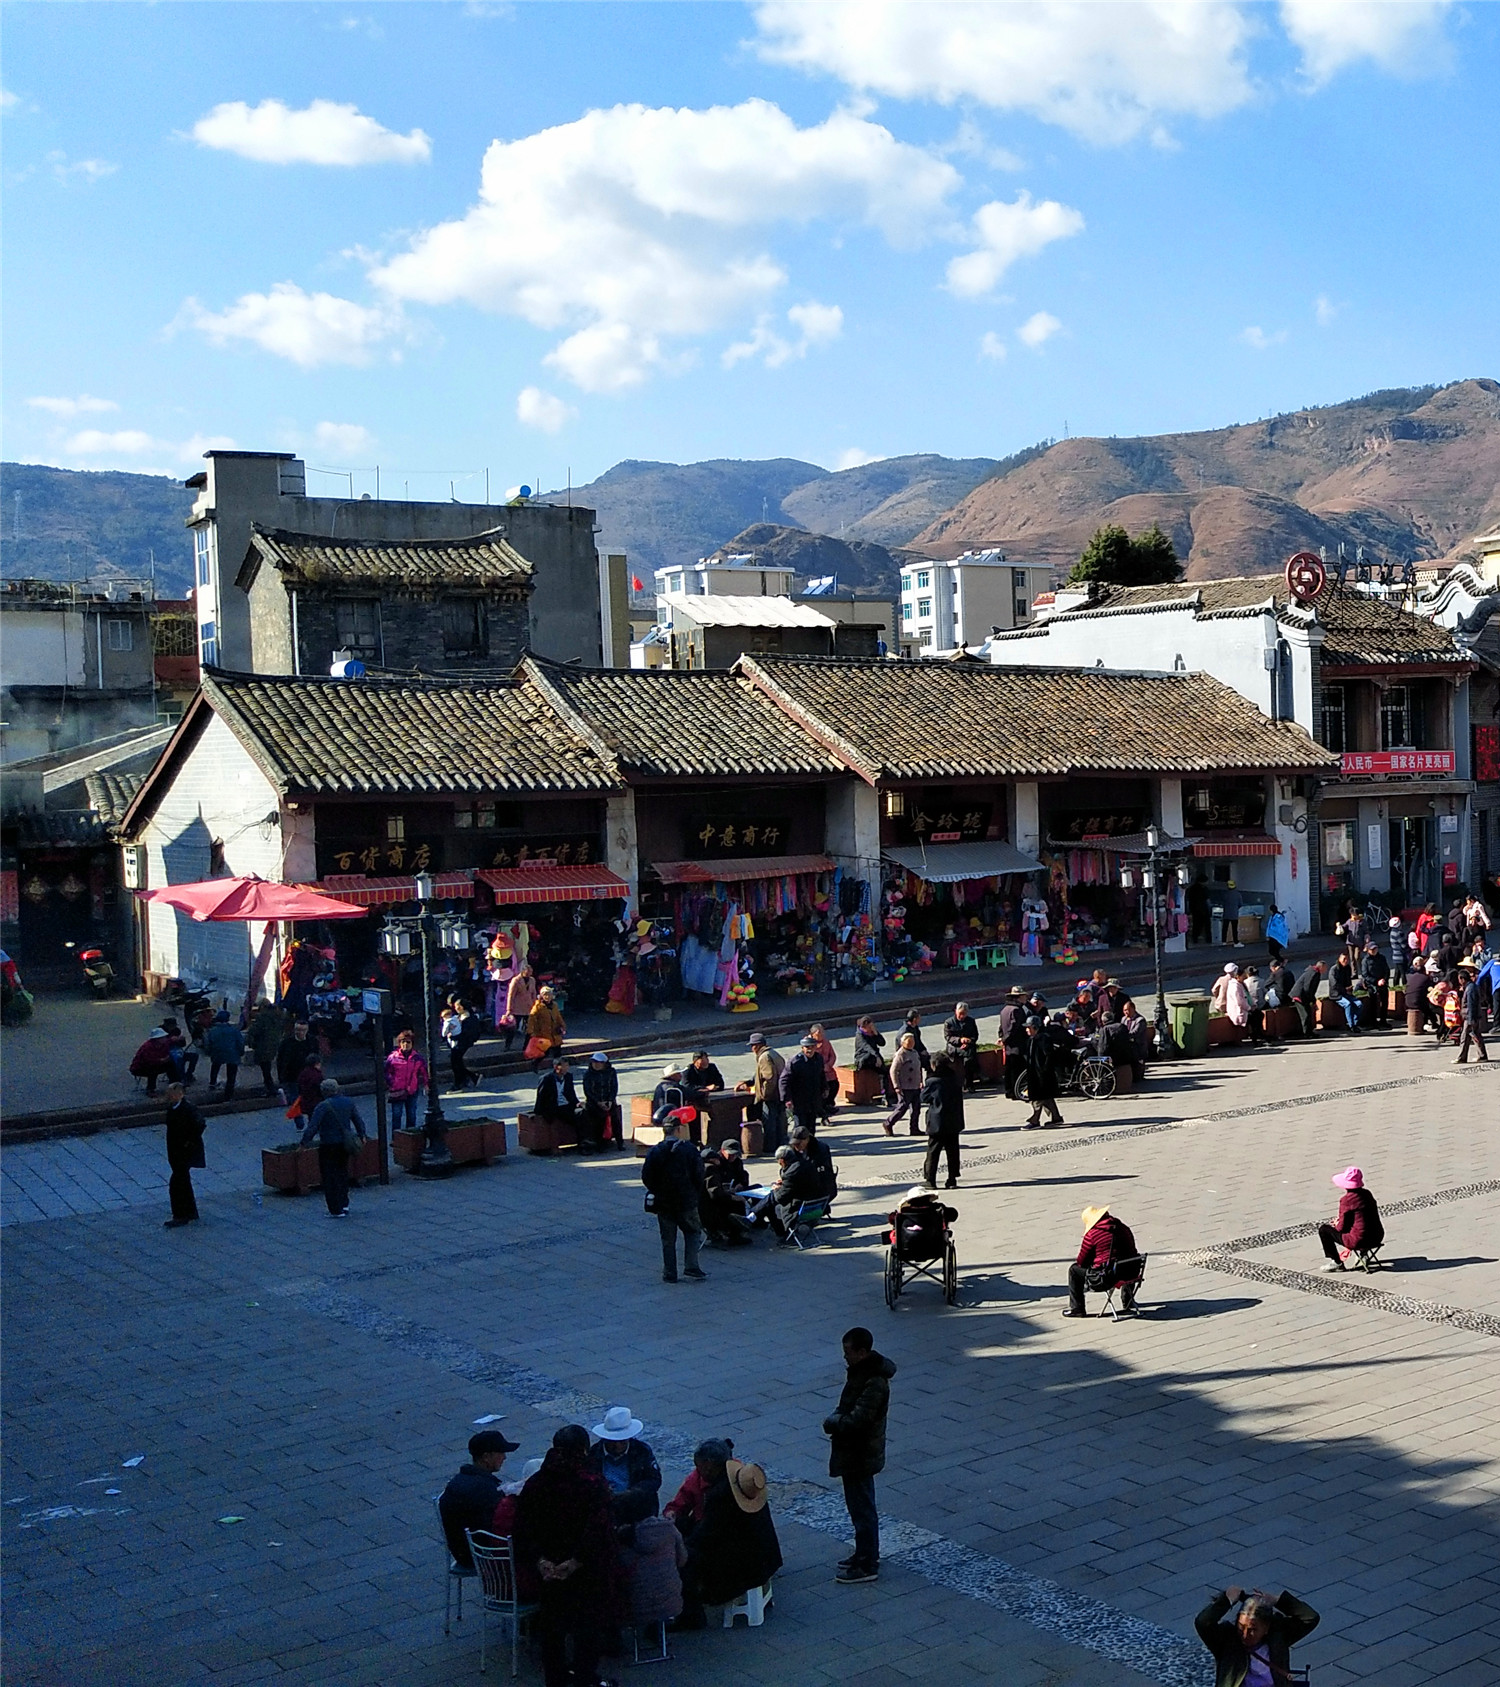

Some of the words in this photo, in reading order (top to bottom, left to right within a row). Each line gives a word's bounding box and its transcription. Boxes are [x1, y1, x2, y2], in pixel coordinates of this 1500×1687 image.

[910, 811, 983, 832] 金玲珑
[699, 823, 780, 848] 中意商行
[333, 844, 431, 871] 百货商店
